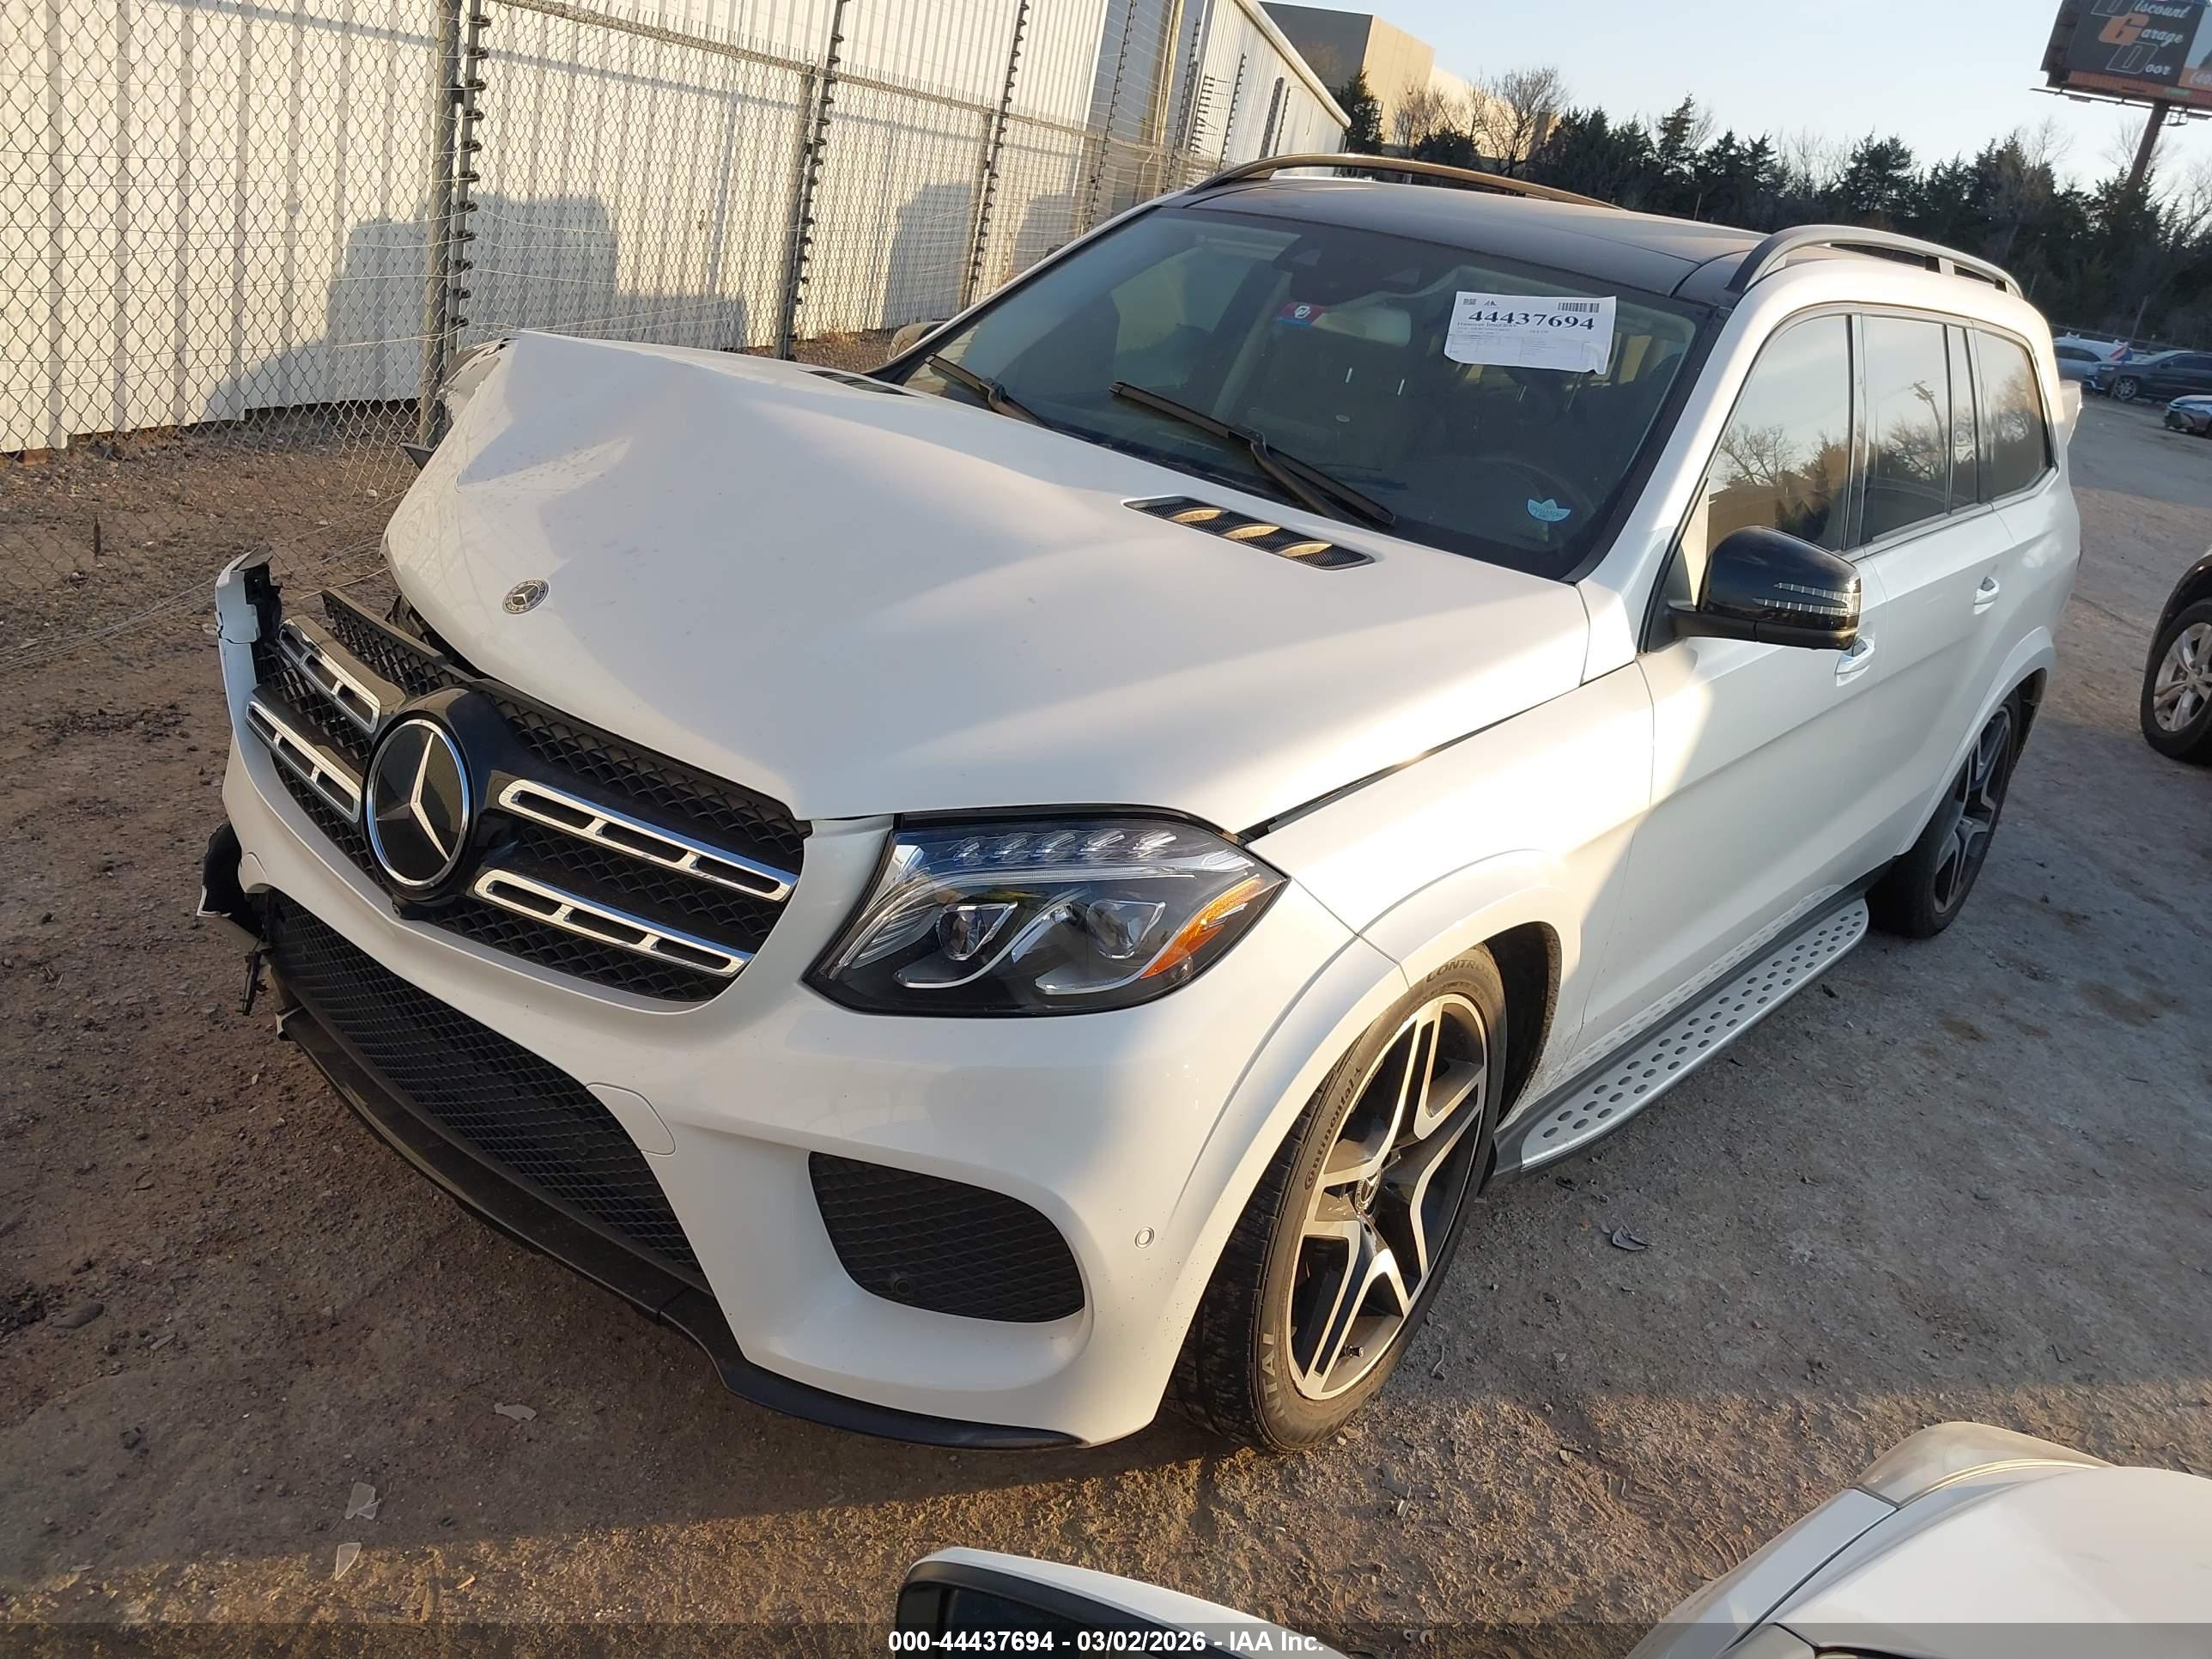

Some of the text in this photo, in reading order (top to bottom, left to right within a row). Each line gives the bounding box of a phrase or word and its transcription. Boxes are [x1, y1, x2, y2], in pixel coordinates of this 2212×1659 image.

[2098, 12, 2184, 46] Garage
[2106, 41, 2171, 75] Door
[1468, 310, 1595, 330] 44437694
